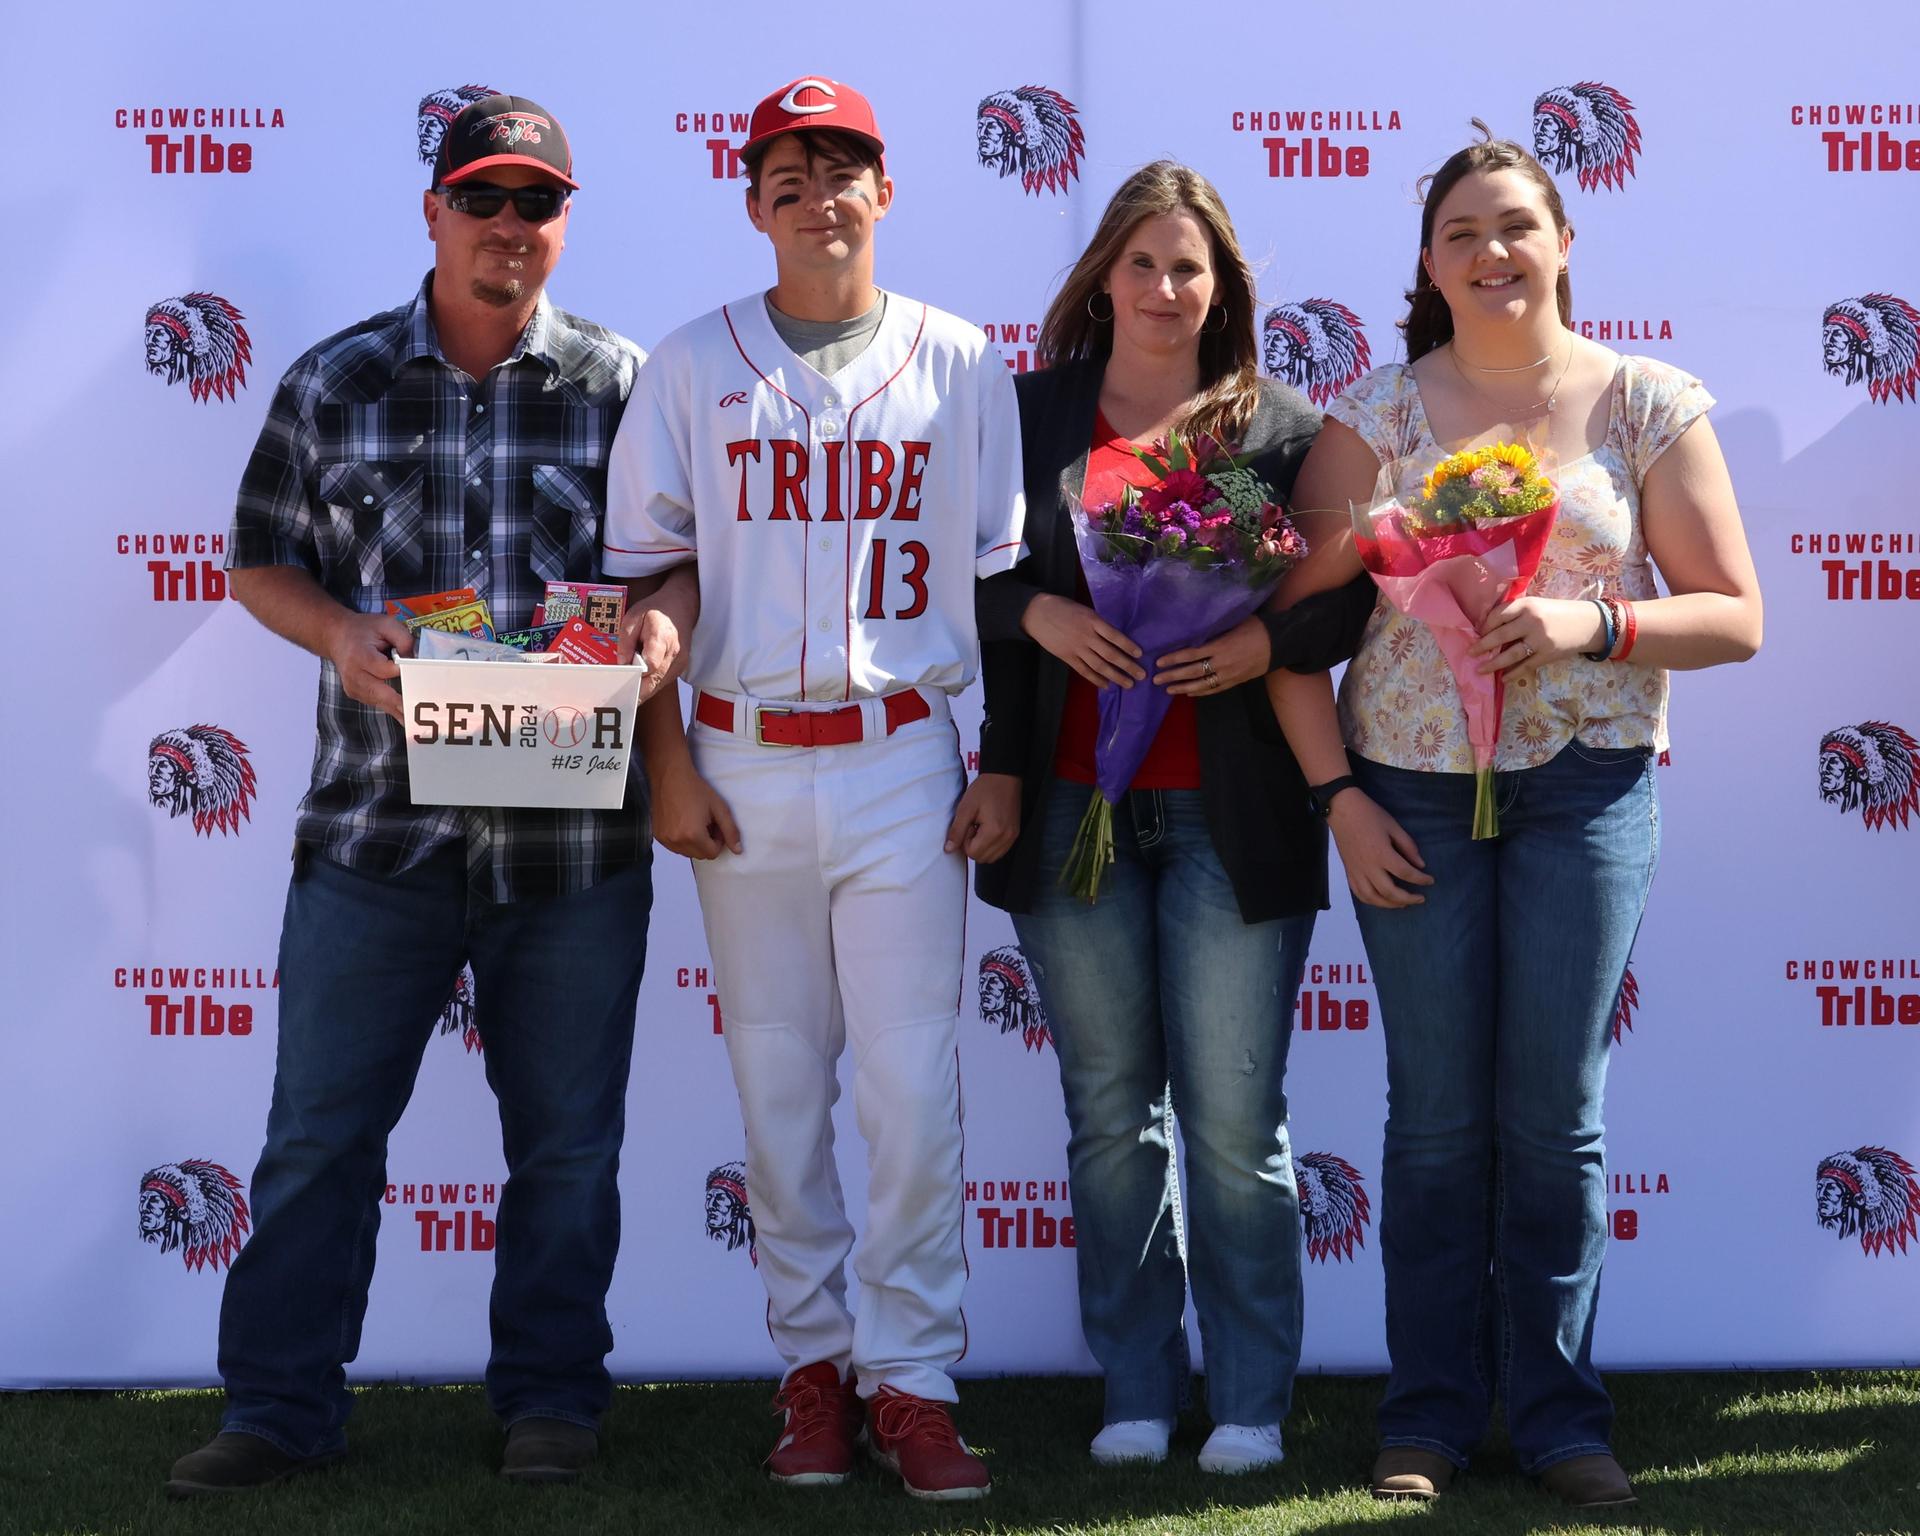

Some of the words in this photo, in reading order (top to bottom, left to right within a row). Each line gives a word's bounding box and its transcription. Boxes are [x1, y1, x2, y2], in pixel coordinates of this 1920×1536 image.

[778, 80, 838, 115] C
[116, 108, 284, 129] CHOWCHILLA
[1233, 111, 1401, 131] CHOWCHILLA
[1791, 104, 1920, 125] CHOWCHI
[1571, 320, 1673, 340] CHILLA
[726, 439, 931, 522] TRIBE
[117, 534, 224, 555] CHOWCH
[1791, 533, 1920, 554] CHOWCHI
[147, 560, 227, 602] Trib
[863, 538, 930, 620] 13
[520, 704, 538, 748] 2024
[551, 754, 583, 770] #13
[586, 754, 621, 775] Jake
[1786, 959, 1920, 980] CHOWCHIL
[1295, 991, 1369, 1030] ibe
[965, 1181, 1067, 1201] HOWCHI
[415, 1210, 496, 1252] Trib
